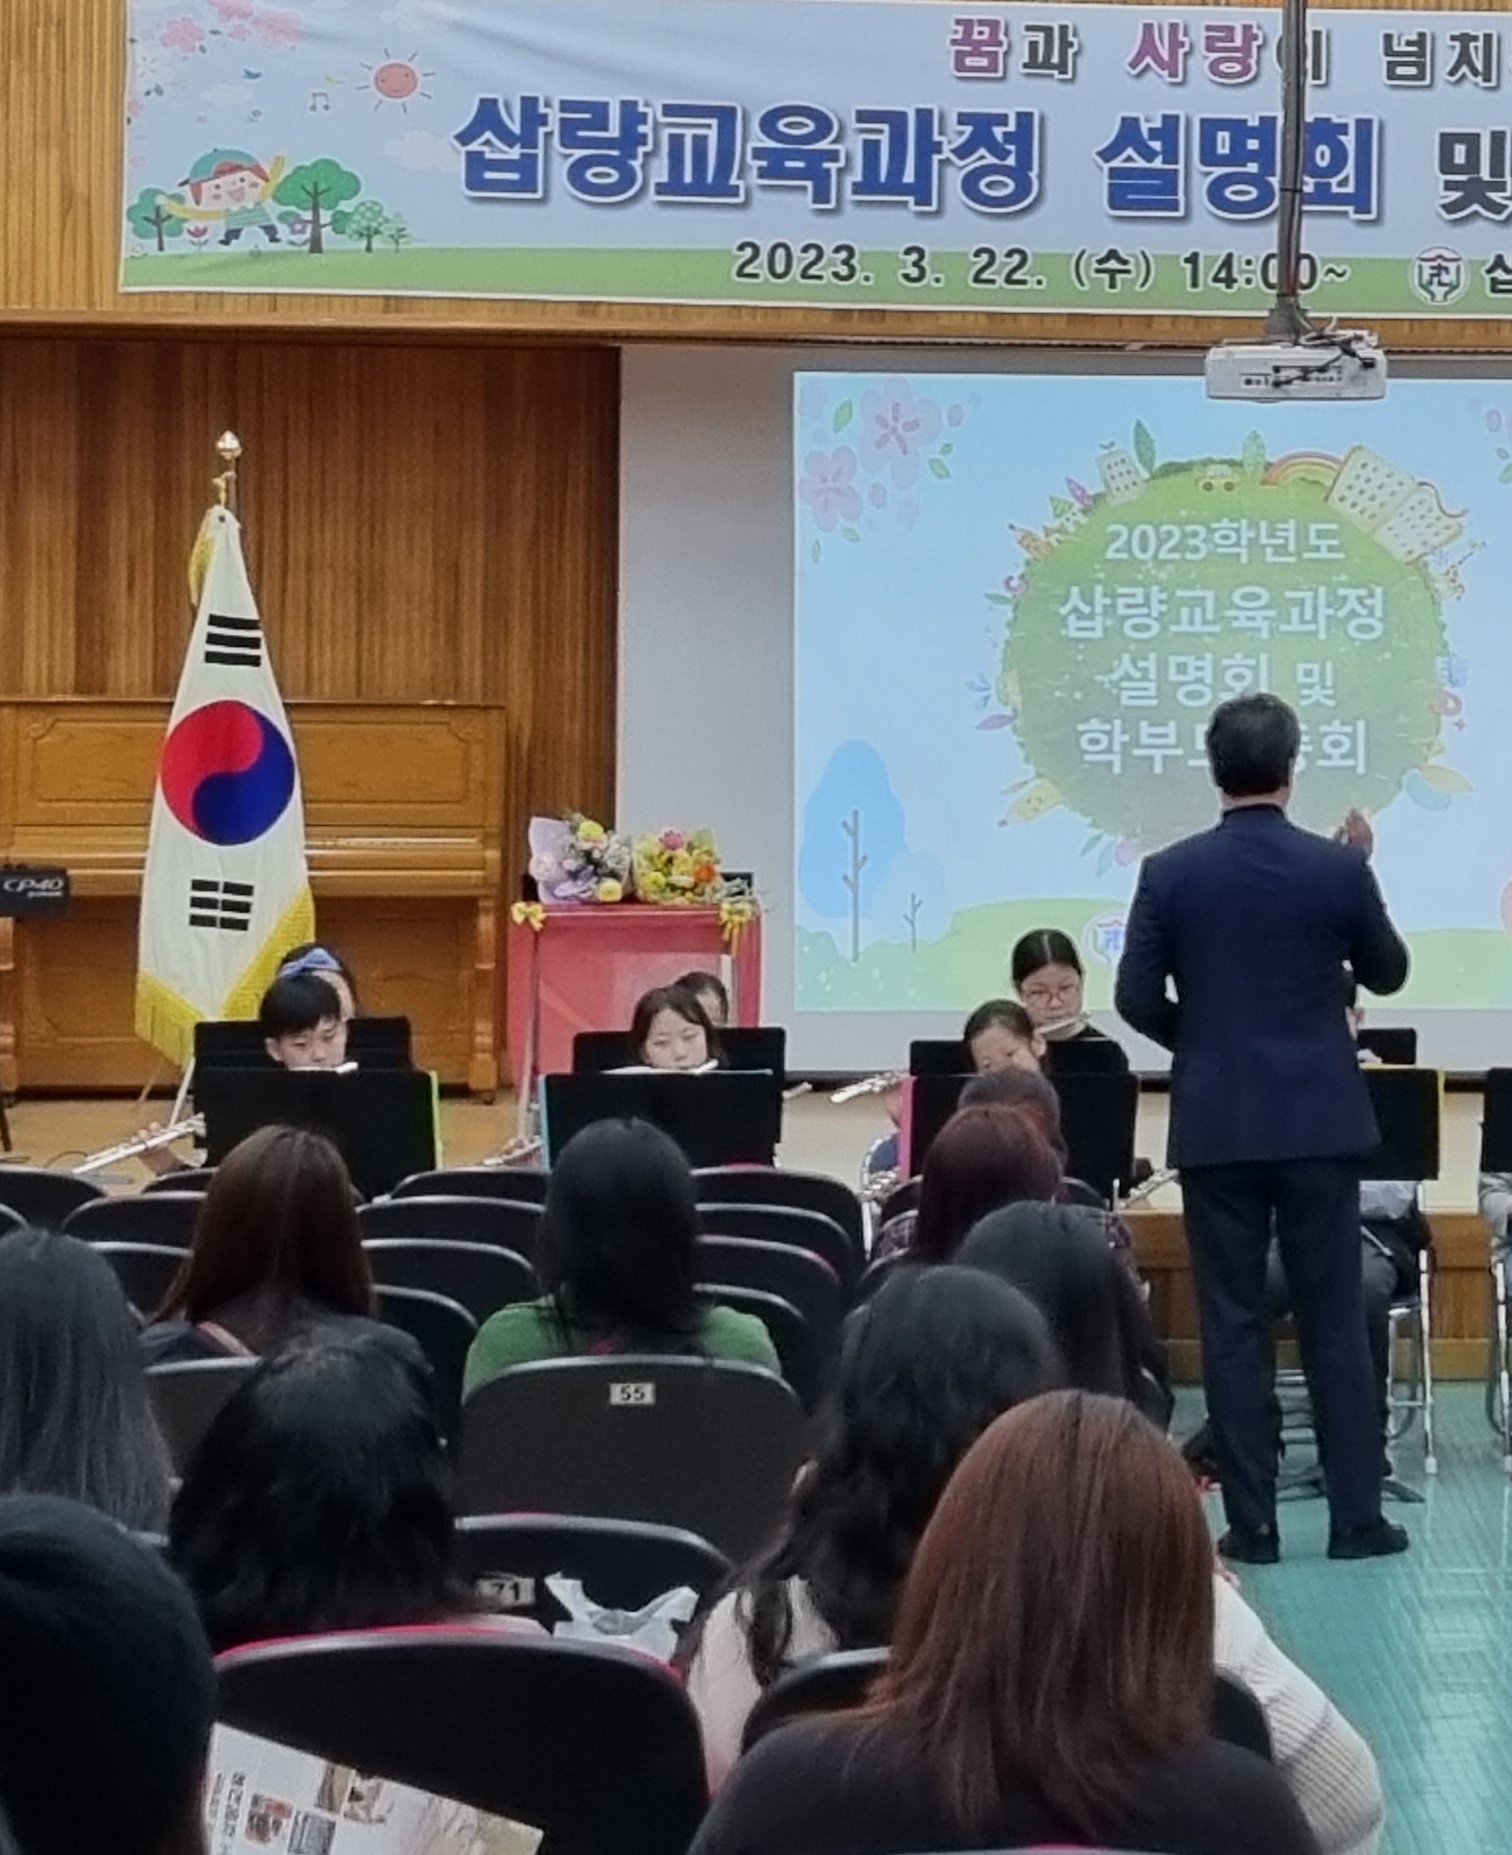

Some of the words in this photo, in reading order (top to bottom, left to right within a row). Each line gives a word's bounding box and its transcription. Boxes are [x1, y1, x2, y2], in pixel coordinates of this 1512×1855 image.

[949, 17, 1077, 79] 꿈과
[451, 95, 1040, 212] 삽량교육과정
[1099, 112, 1376, 218] 설명회
[734, 240, 874, 283] 2023.
[900, 245, 944, 284] 3.
[971, 246, 1044, 286] 22.
[1074, 248, 1151, 290] (수)
[1104, 518, 1347, 564] 2023학년도
[1058, 584, 1386, 640] 삽량교육과정
[1107, 652, 1270, 707] 설명회
[1296, 660, 1337, 707] 및
[1076, 717, 1367, 775] 학부회
[620, 1384, 646, 1401] 55
